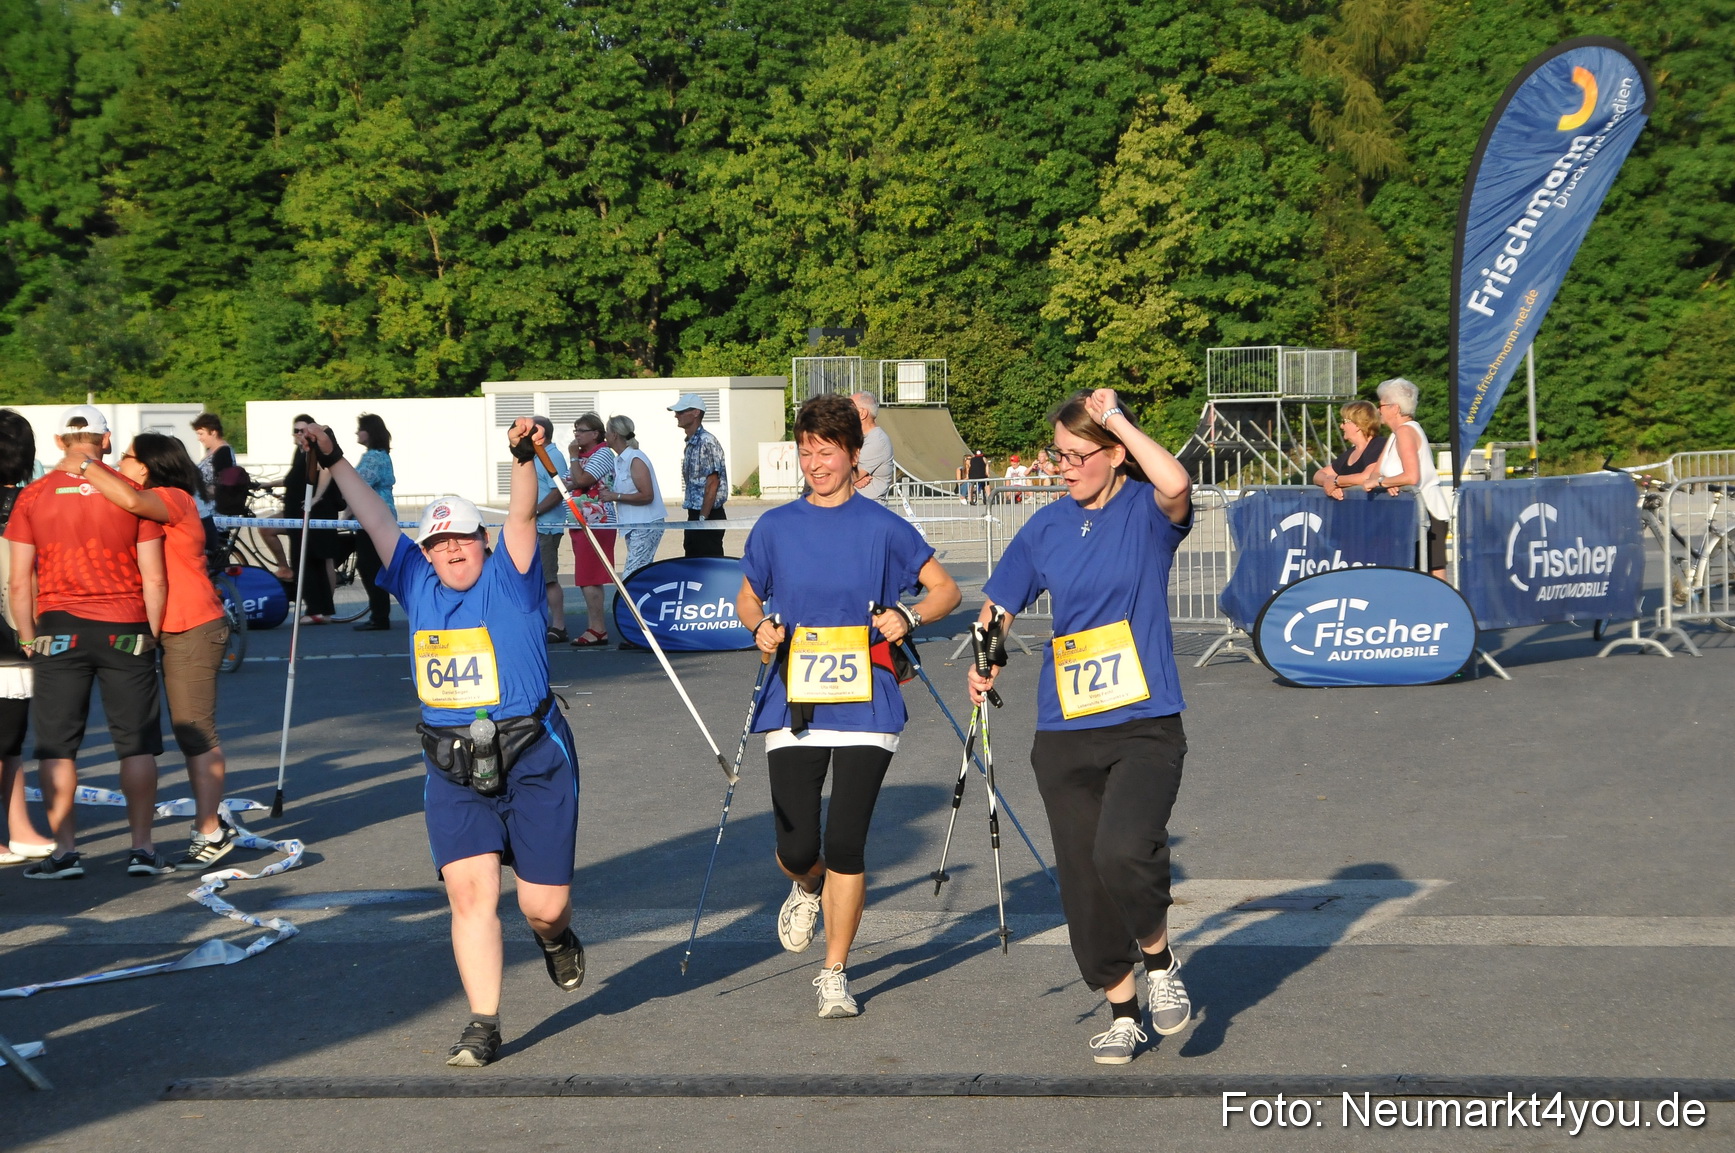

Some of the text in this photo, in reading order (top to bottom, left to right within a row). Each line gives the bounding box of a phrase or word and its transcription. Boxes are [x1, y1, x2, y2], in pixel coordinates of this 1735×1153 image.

[1553, 165, 1588, 209] Druck
[1466, 135, 1593, 317] Frischmann
[1465, 289, 1539, 424] www.frischmann-net.de
[1528, 536, 1617, 578] Fischer
[1535, 581, 1610, 601] AUTOMOBILE
[659, 597, 735, 621] Fisch
[669, 620, 746, 632] AUTOMOBI
[1314, 618, 1449, 648] Fischer
[799, 653, 858, 683] 725
[1327, 645, 1440, 662] AUTOMOBILE
[426, 655, 483, 689] 644
[1063, 652, 1122, 695] 727
